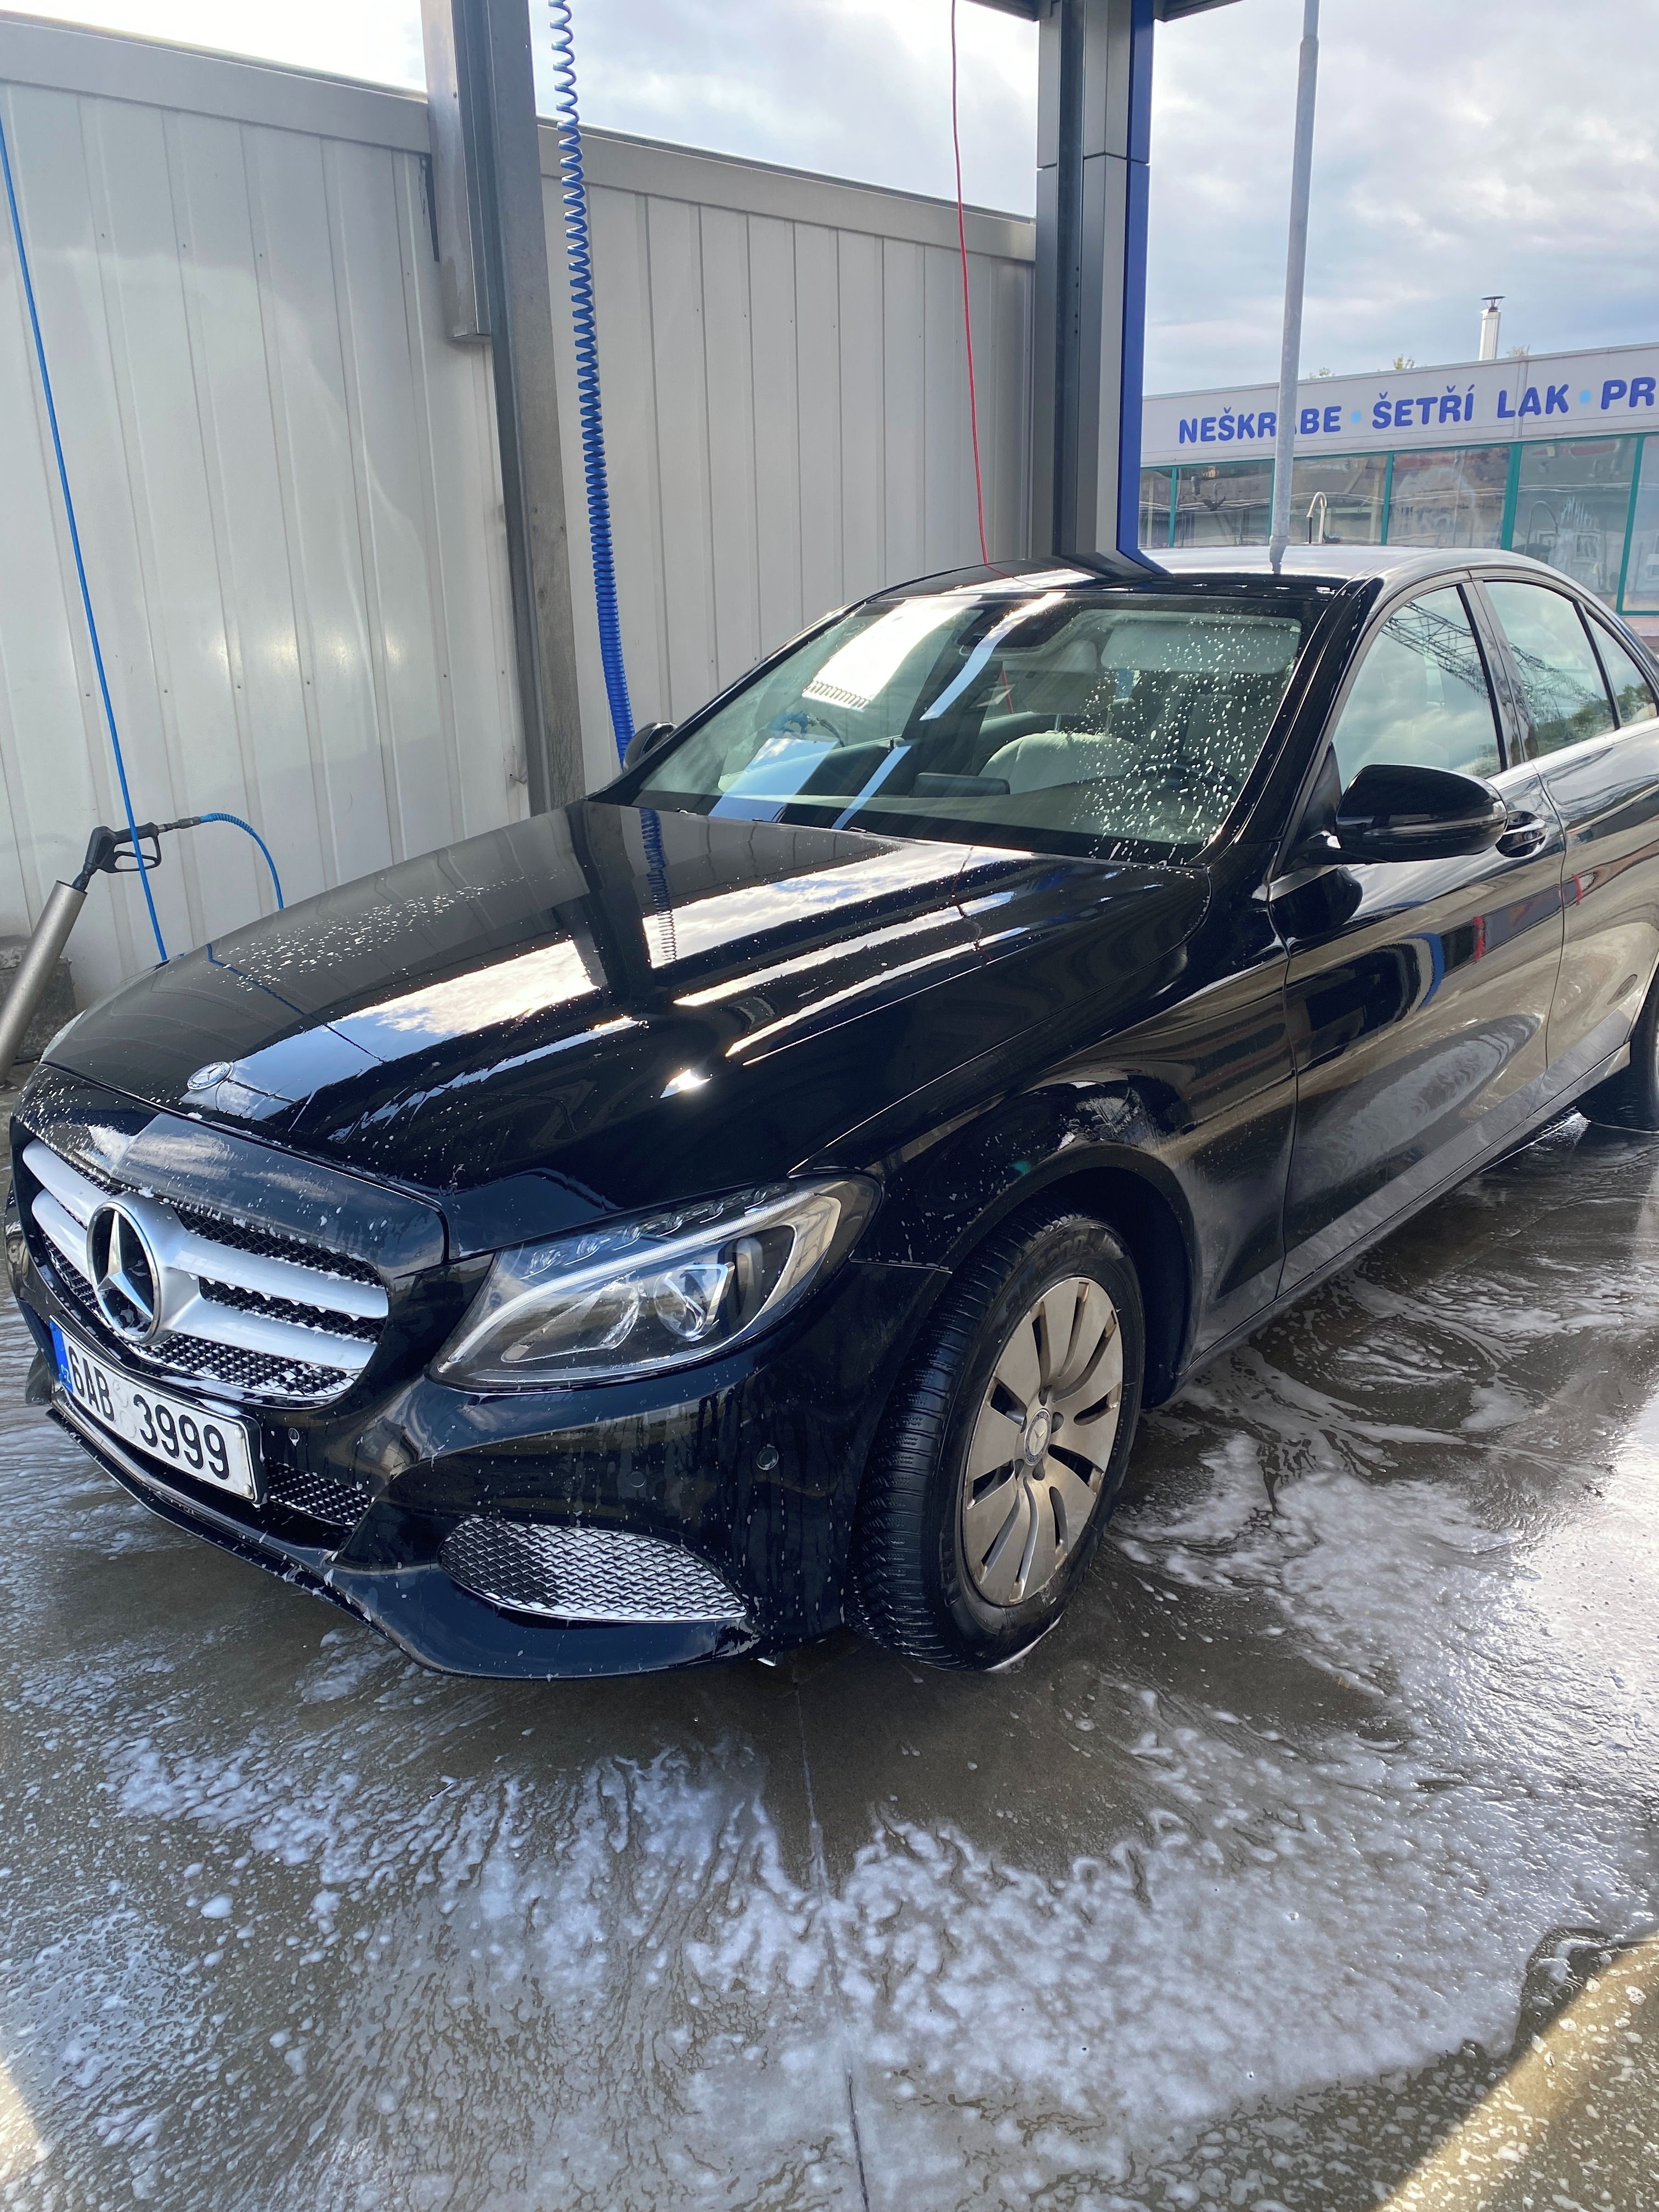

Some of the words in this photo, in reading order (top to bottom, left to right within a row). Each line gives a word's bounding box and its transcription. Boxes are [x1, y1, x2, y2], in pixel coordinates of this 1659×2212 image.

[1179, 405, 1342, 444] NEŠKRBE
[1372, 383, 1475, 429] ŠETŘÍ
[1497, 383, 1569, 418] LAK
[69, 1346, 115, 1422] 6AB
[133, 1393, 230, 1480] 3999
